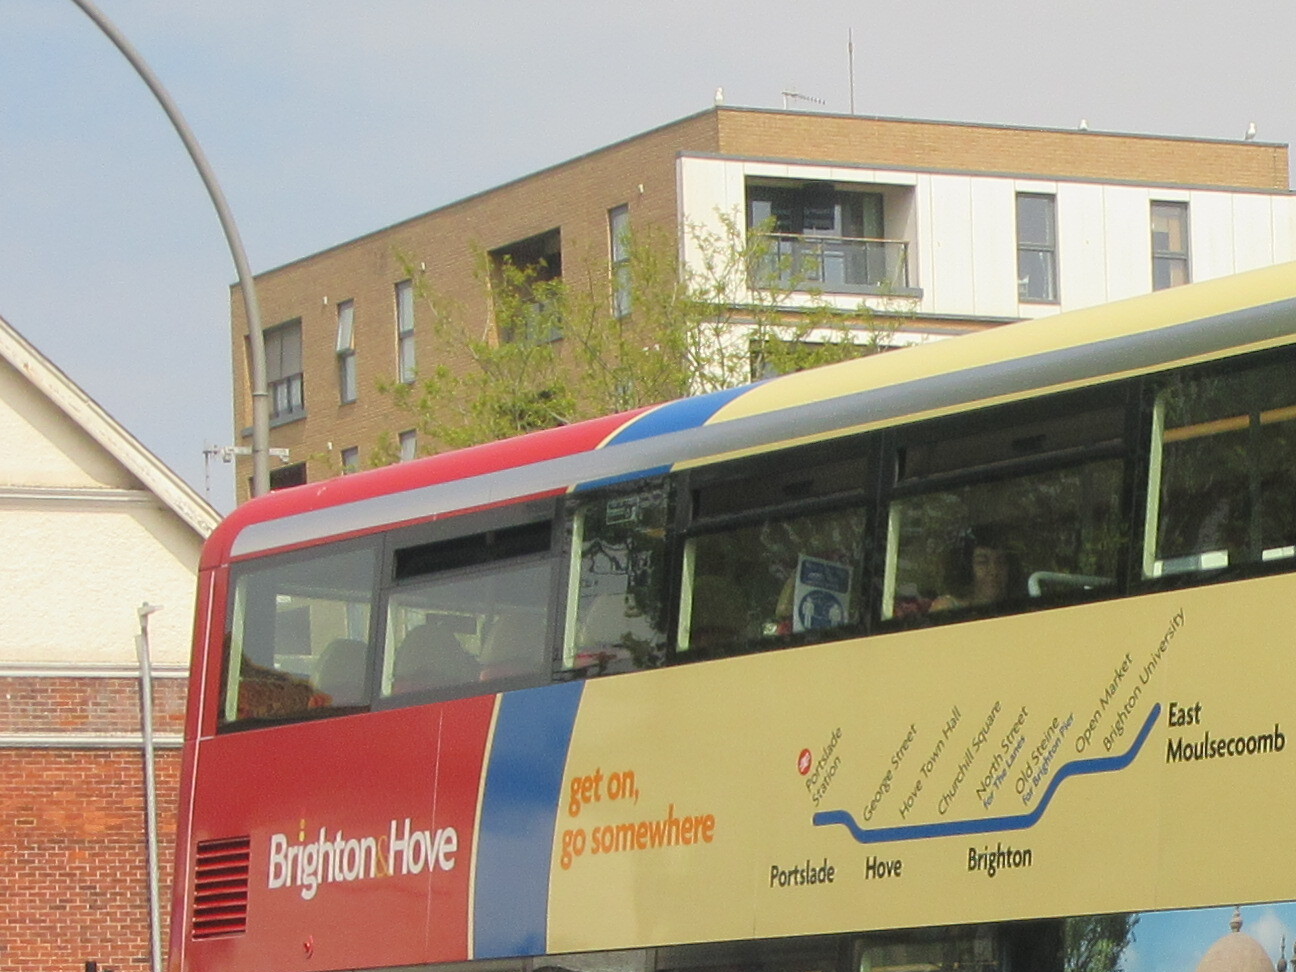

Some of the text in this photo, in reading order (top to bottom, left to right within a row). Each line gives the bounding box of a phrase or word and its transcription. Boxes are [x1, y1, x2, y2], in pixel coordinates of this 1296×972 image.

[1075, 653, 1133, 753] Open Market
[1103, 607, 1186, 752] Brighton University
[1166, 723, 1285, 763] Moulsecoomb
[1168, 701, 1202, 728] East
[805, 727, 843, 793] Portslade
[812, 755, 842, 808] Station
[863, 723, 918, 822] George Street
[899, 705, 962, 820] Hove Town Hall
[938, 701, 1002, 816] Churchill Square
[976, 705, 1029, 801] North Street
[1015, 717, 1060, 795] Old Steine
[568, 768, 640, 818] get on,
[560, 803, 715, 871] go somewhere
[865, 856, 902, 880] Hove
[967, 842, 1033, 874] Brighton
[770, 858, 835, 888] Portslade
